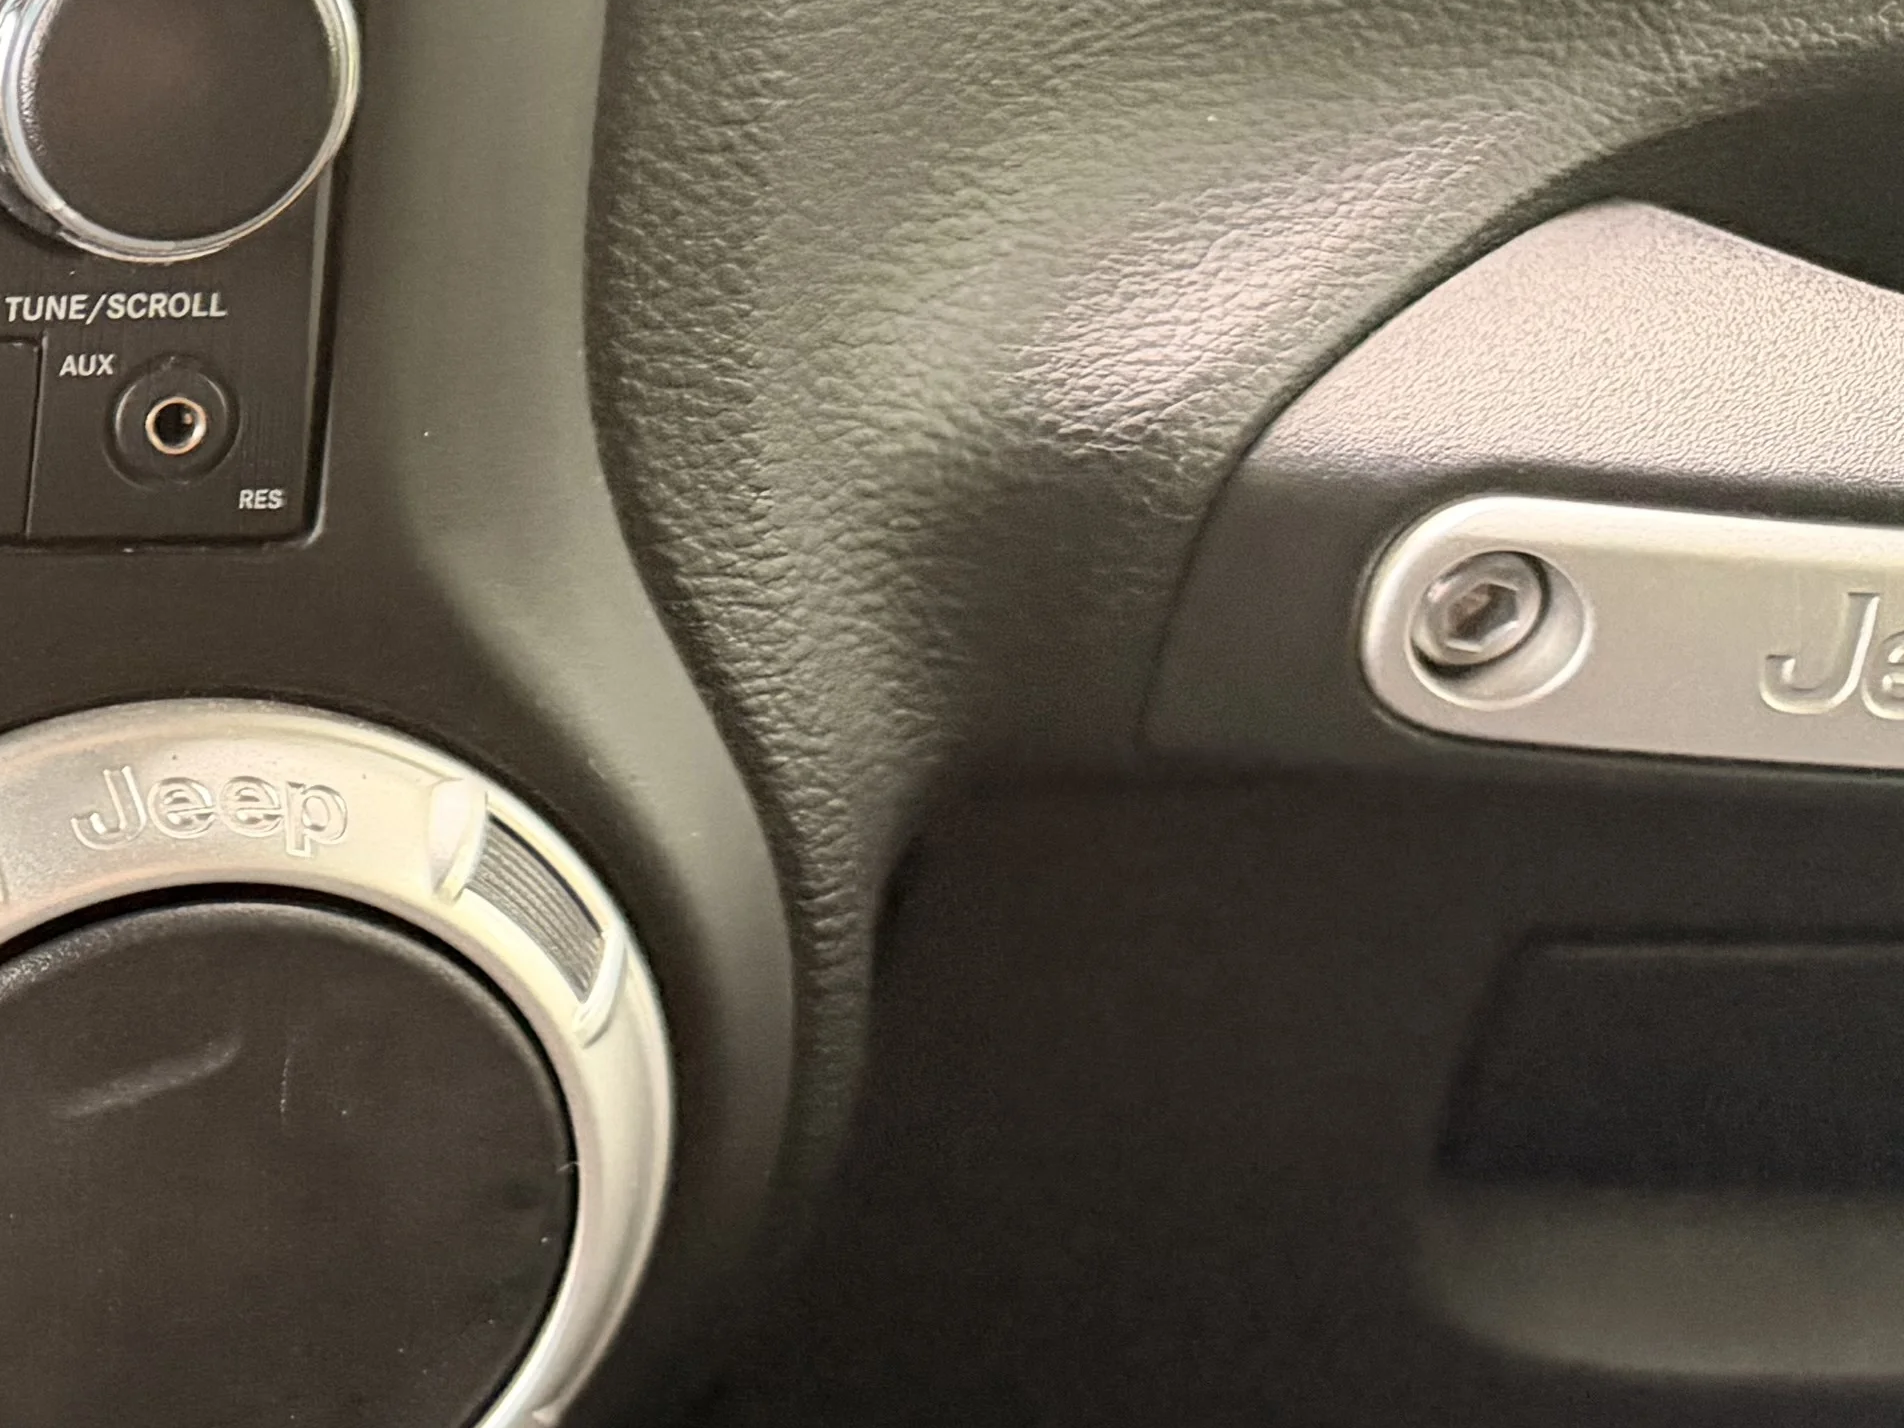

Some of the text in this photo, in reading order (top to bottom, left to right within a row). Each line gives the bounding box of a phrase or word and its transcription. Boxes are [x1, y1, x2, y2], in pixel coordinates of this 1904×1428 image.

[5, 292, 227, 325] TUNE/SCROLL
[59, 353, 115, 377] AUX
[238, 488, 285, 510] RES
[69, 766, 348, 858] Jeep
